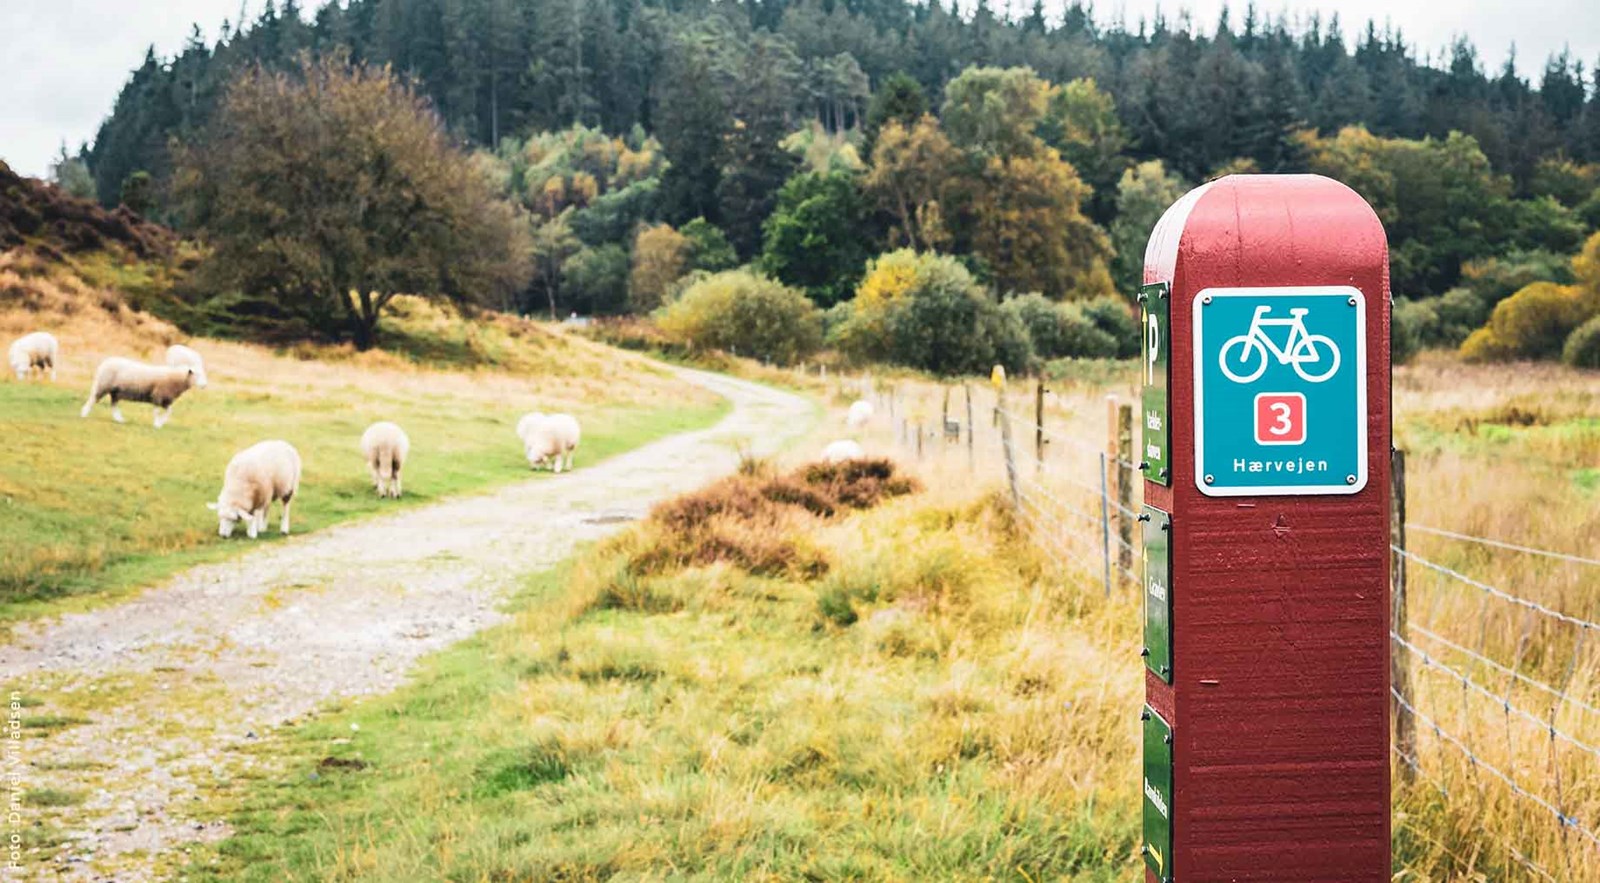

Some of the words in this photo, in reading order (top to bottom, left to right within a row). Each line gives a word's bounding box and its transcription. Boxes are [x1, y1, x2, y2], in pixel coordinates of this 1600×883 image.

[1149, 313, 1159, 386] P
[1269, 402, 1292, 435] 3
[1233, 457, 1328, 474] Hærvejen
